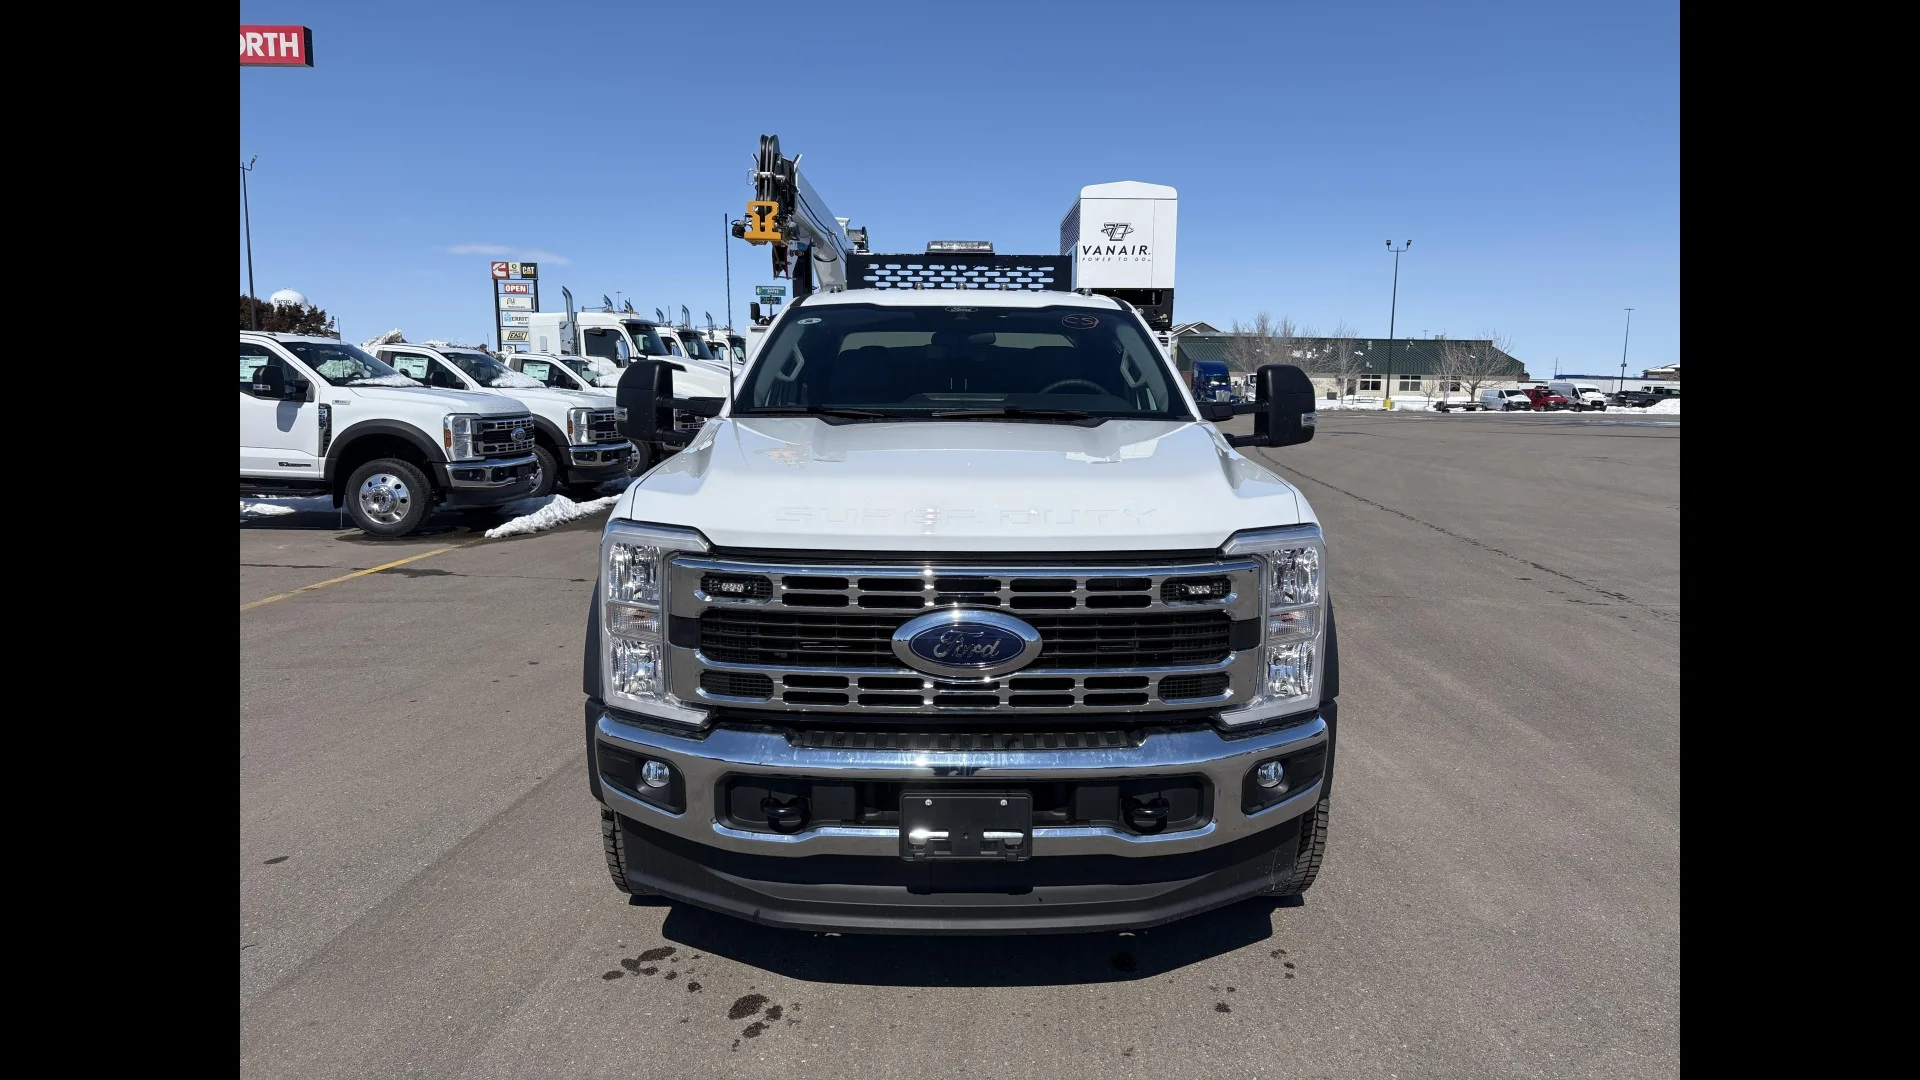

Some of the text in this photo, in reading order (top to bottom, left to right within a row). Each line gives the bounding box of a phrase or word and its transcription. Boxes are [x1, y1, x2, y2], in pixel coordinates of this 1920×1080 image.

[522, 266, 535, 274] CAT
[773, 507, 1159, 526] SUPER DUTY
[932, 629, 1002, 659] Ford
